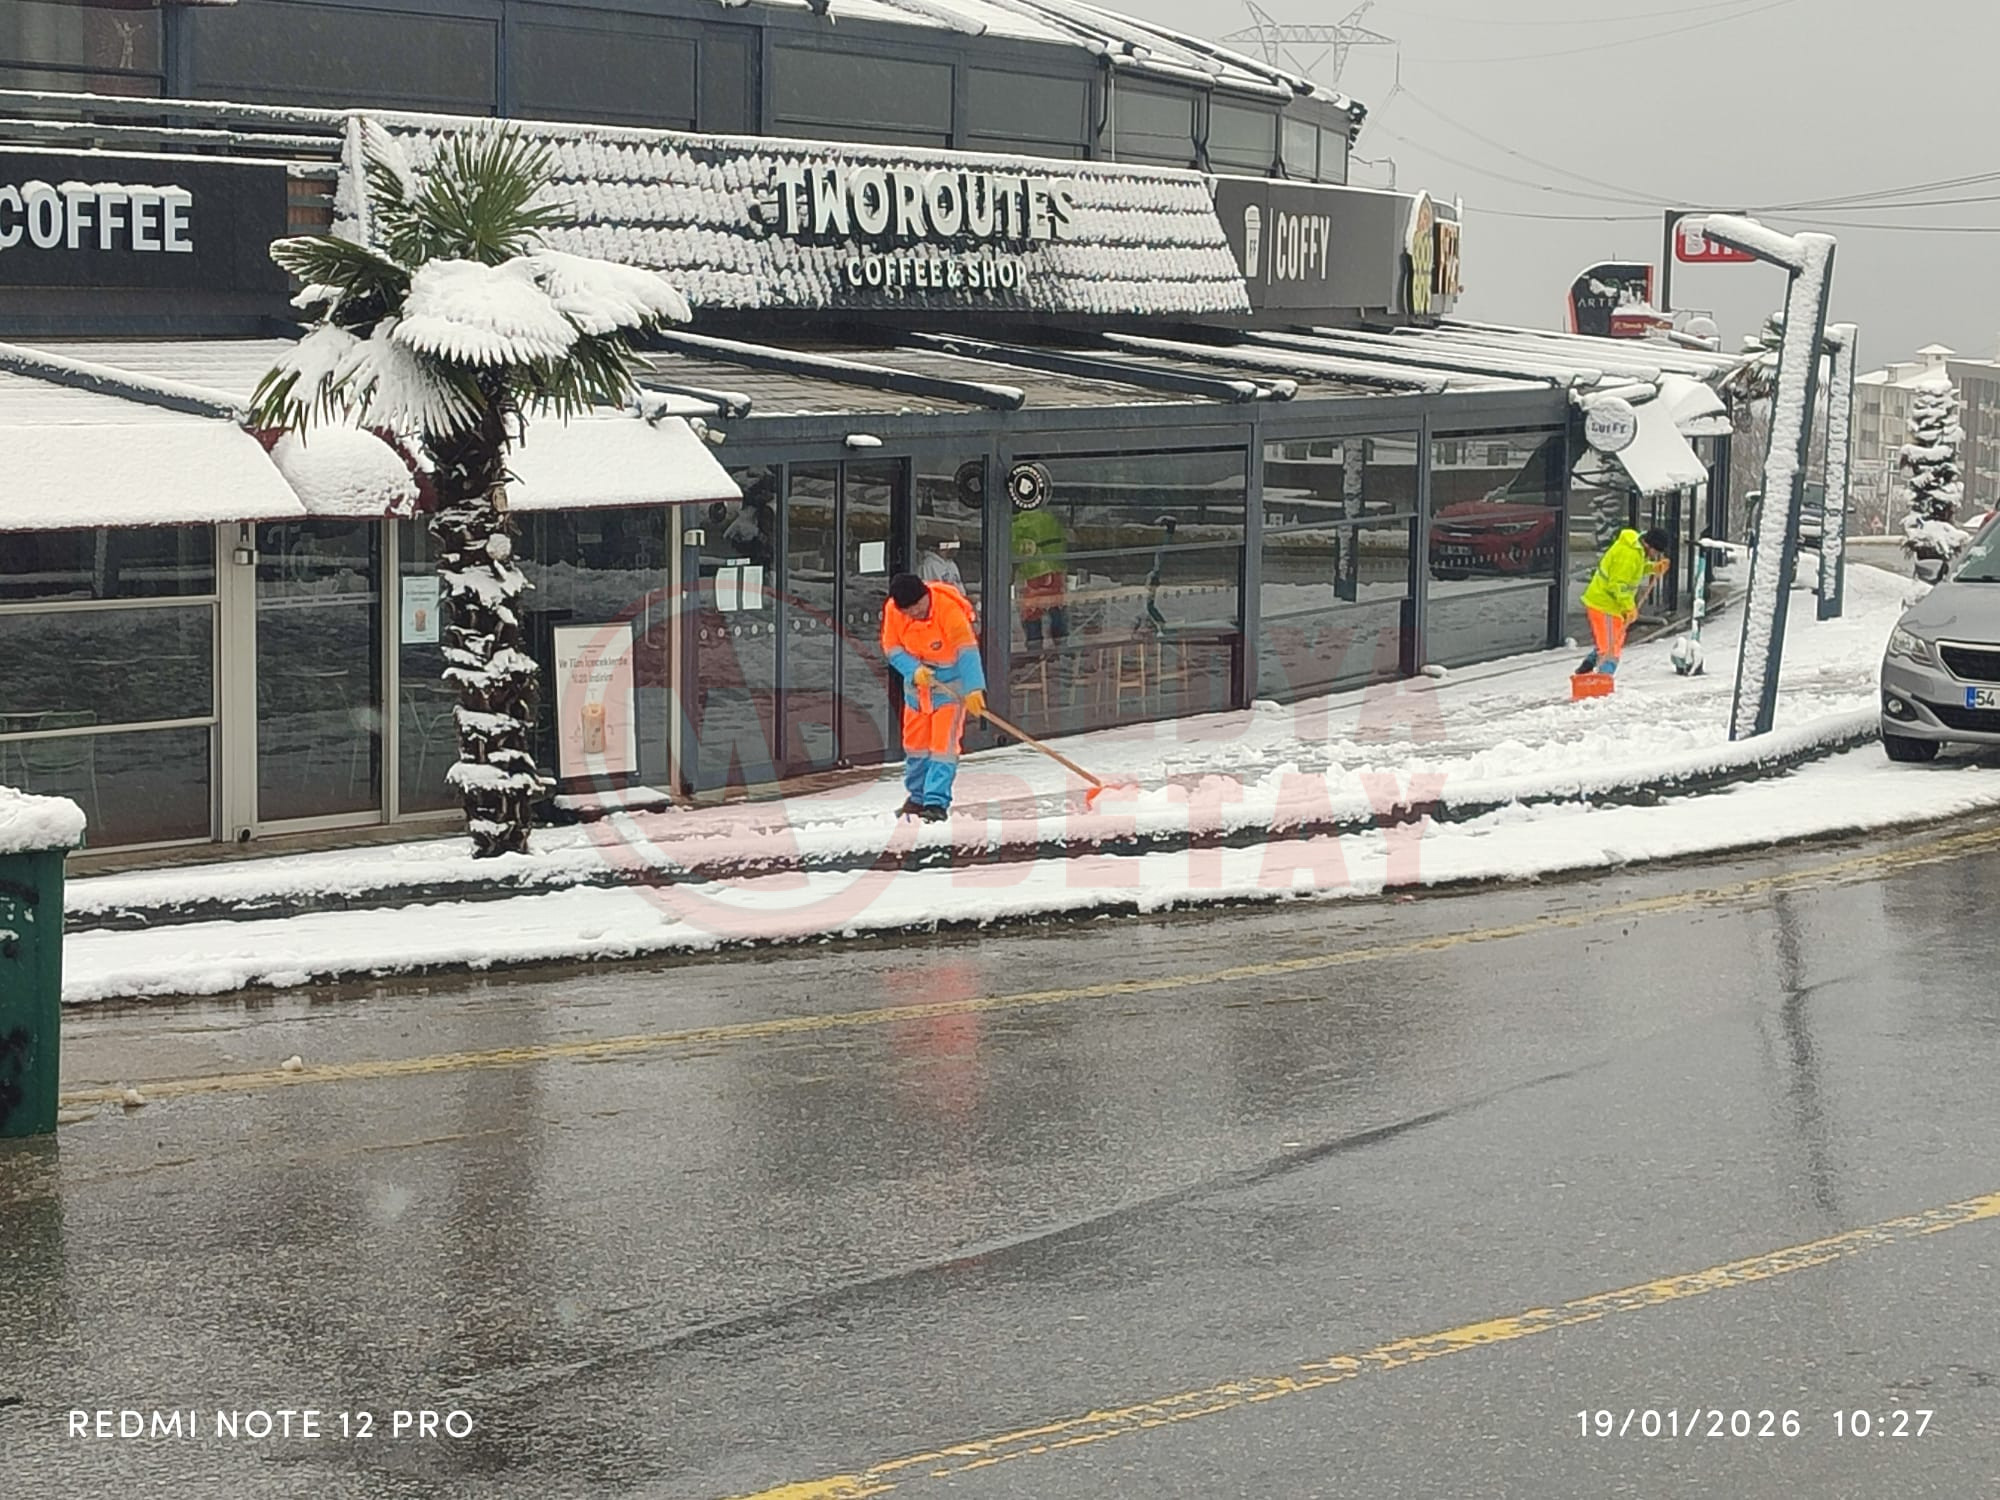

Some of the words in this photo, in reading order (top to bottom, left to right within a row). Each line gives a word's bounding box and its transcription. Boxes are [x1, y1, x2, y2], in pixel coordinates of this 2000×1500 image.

[0, 184, 193, 252] COFFEE
[776, 163, 1076, 240] TWOROUTES
[1276, 212, 1331, 281] COFFY
[967, 258, 1026, 288] SHOP
[1577, 297, 1615, 308] ARTE
[1976, 690, 1995, 707] 54
